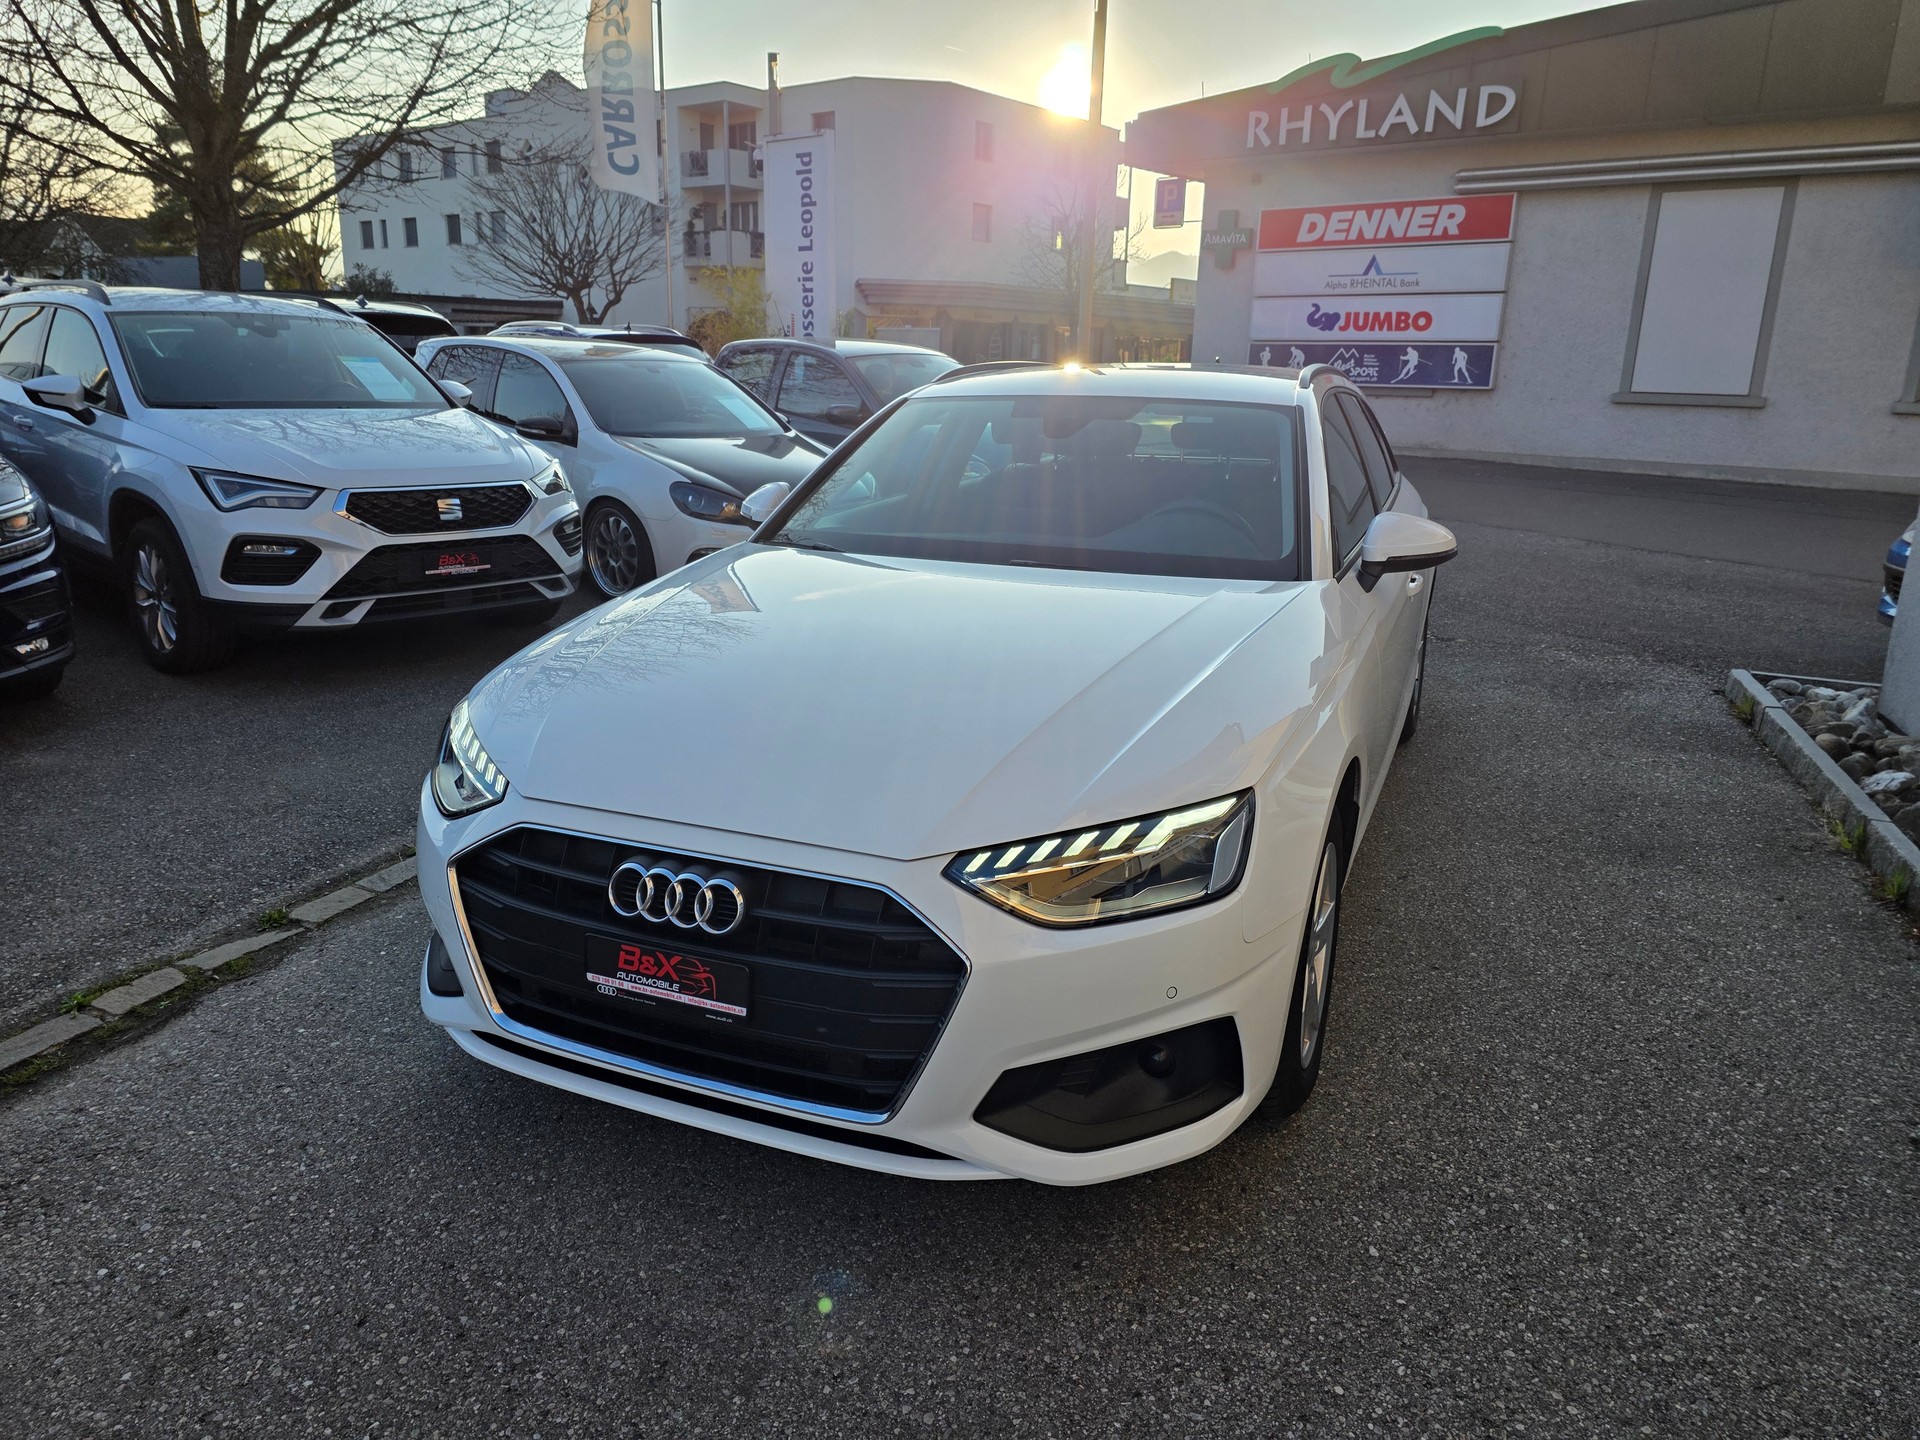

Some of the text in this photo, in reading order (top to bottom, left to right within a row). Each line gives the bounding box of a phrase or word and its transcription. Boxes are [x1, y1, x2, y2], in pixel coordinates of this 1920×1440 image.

[1246, 85, 1516, 148] RHYLAND
[796, 152, 817, 252] Leopold
[1296, 204, 1466, 243] DENNER
[1324, 277, 1420, 291] Alpha RHEINTAL Bank
[1338, 311, 1433, 332] JUMBO
[1349, 367, 1379, 377] SPORT
[618, 944, 683, 980] B&X
[617, 971, 680, 992] AUTOMOBILE
